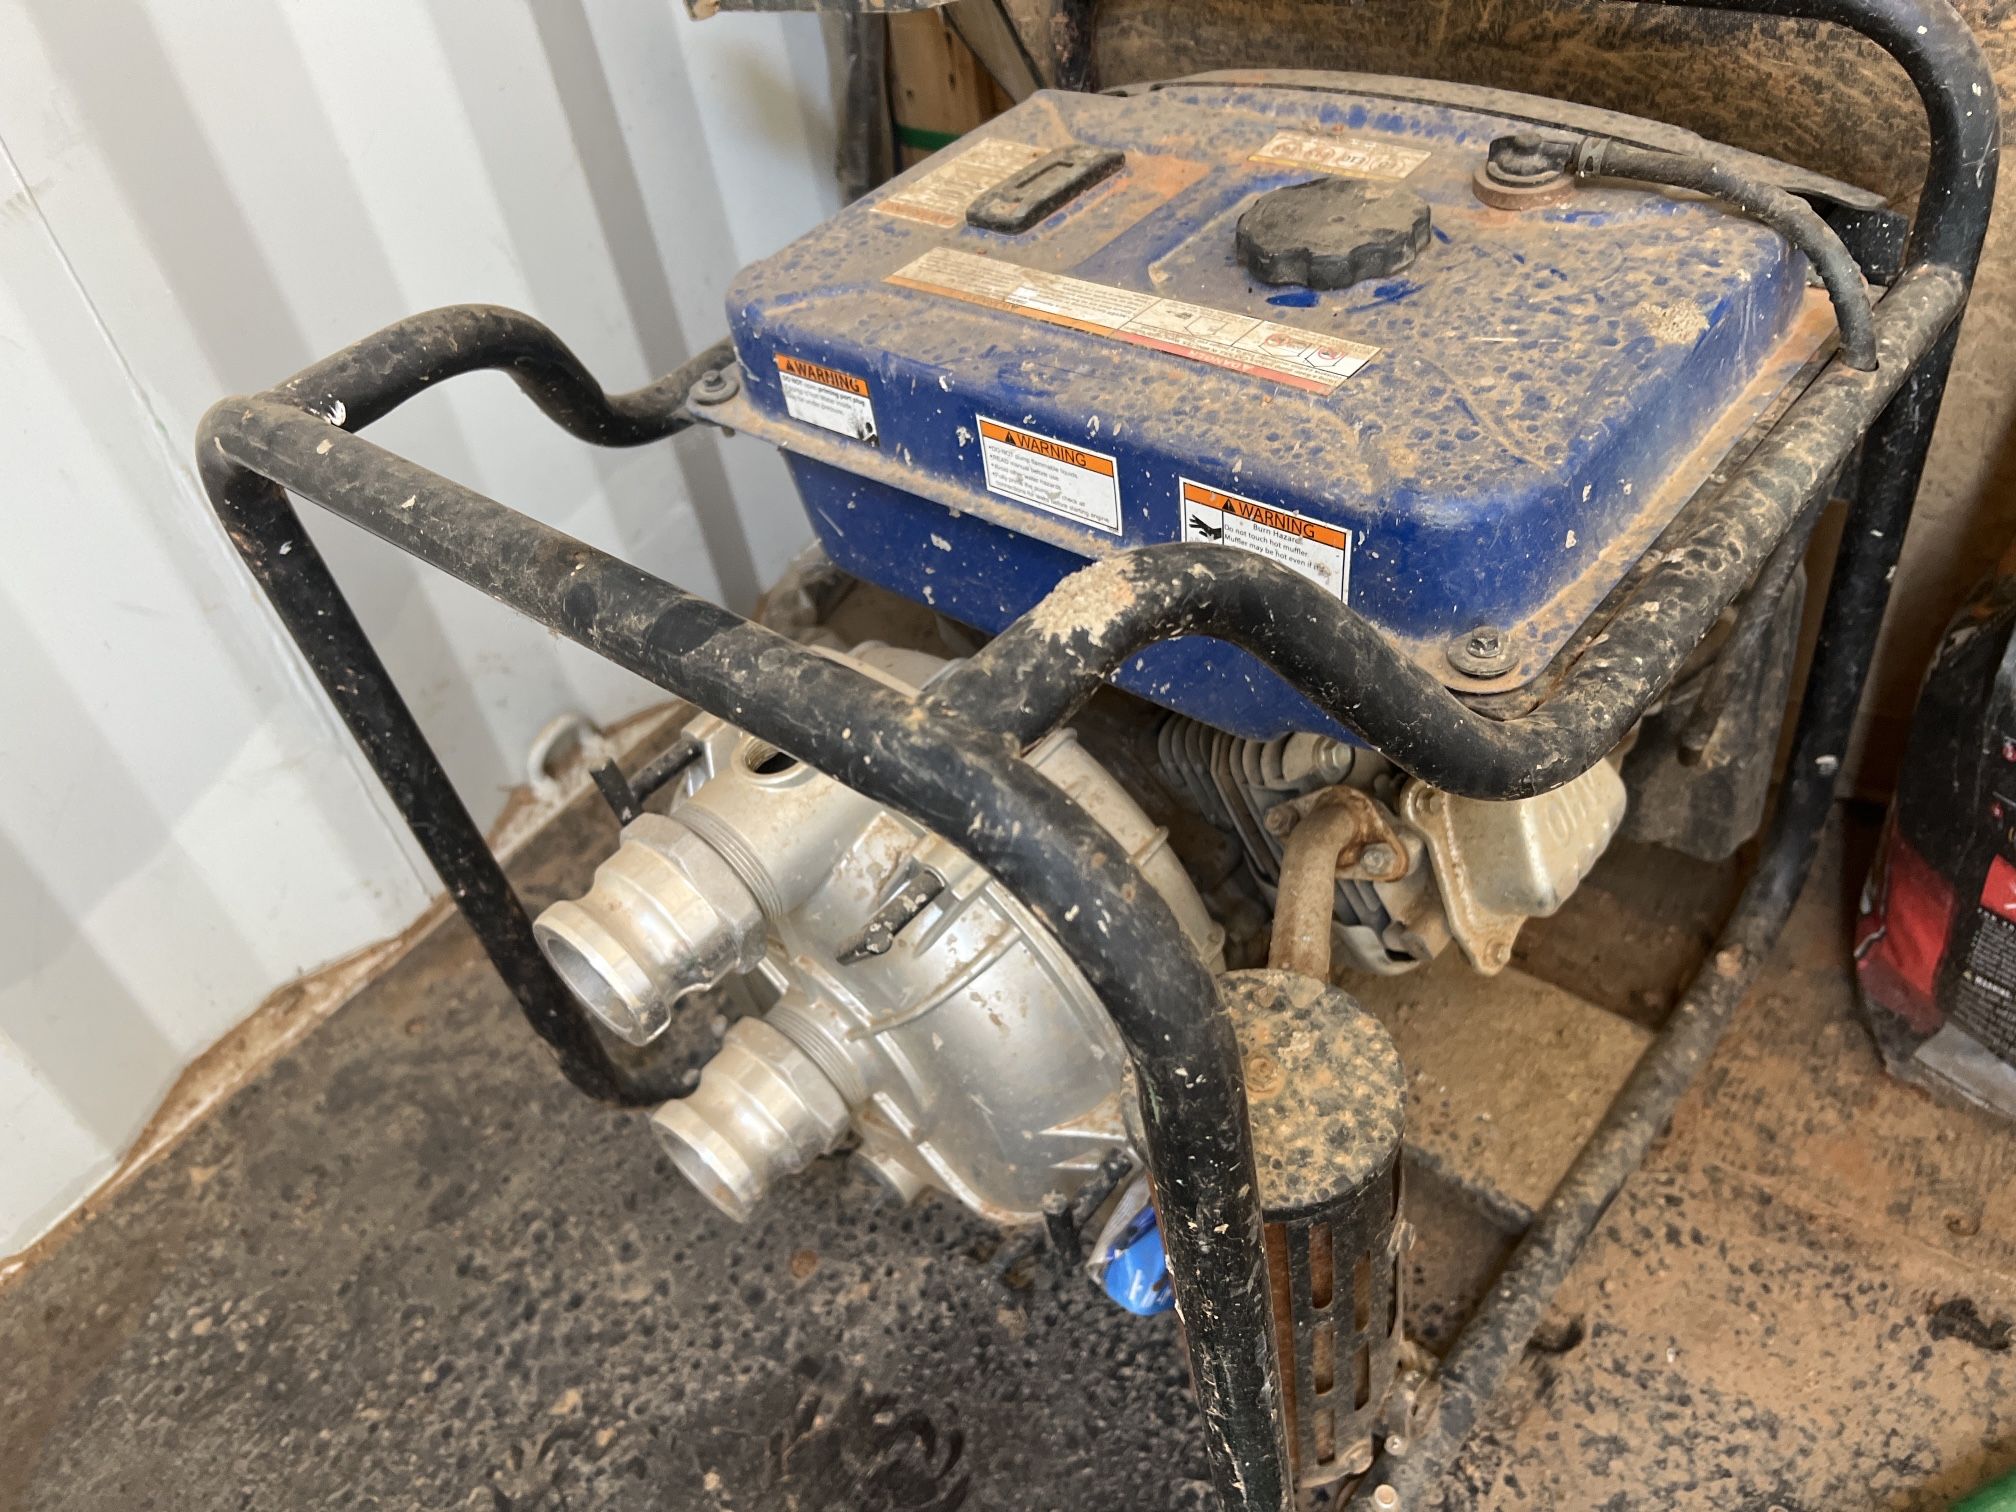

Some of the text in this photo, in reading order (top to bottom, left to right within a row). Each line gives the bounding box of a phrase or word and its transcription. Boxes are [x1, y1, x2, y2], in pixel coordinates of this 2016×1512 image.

[1189, 350, 1241, 368] DANGER
[795, 360, 860, 393] WARNING
[1017, 433, 1087, 467] WARNING
[1224, 524, 1234, 532] Do
[1235, 528, 1247, 537] not
[1248, 532, 1268, 544] touch
[1269, 539, 1281, 548] hot
[1239, 502, 1315, 538] WARNING
[1253, 523, 1271, 535] Burn
[1224, 533, 1247, 546] Muffler
[1249, 543, 1264, 553] may
[1265, 547, 1274, 556] be
[1275, 549, 1287, 560] hot
[1288, 556, 1306, 567] even
